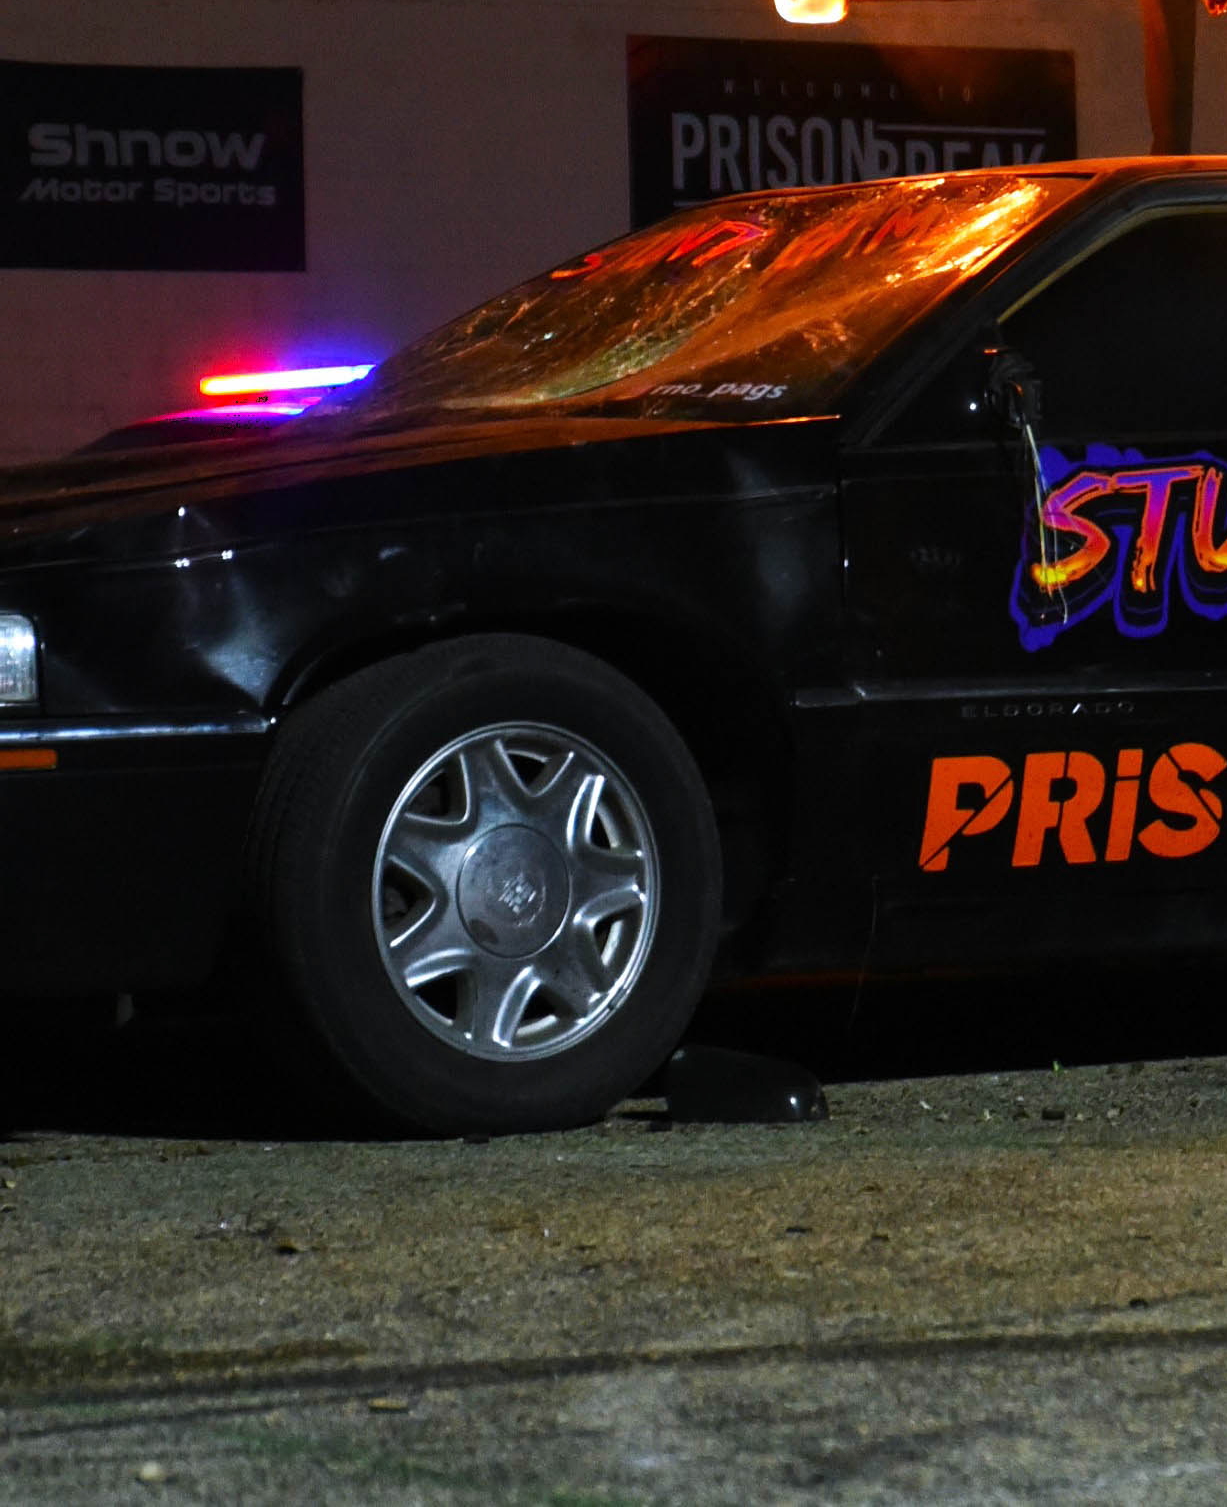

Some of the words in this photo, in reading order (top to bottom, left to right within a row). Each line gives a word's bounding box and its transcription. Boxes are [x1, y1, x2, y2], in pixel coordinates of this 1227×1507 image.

[27, 122, 267, 171] Shnow
[671, 112, 874, 191] PRISON
[18, 177, 144, 203] Motor
[152, 176, 277, 208] Sports
